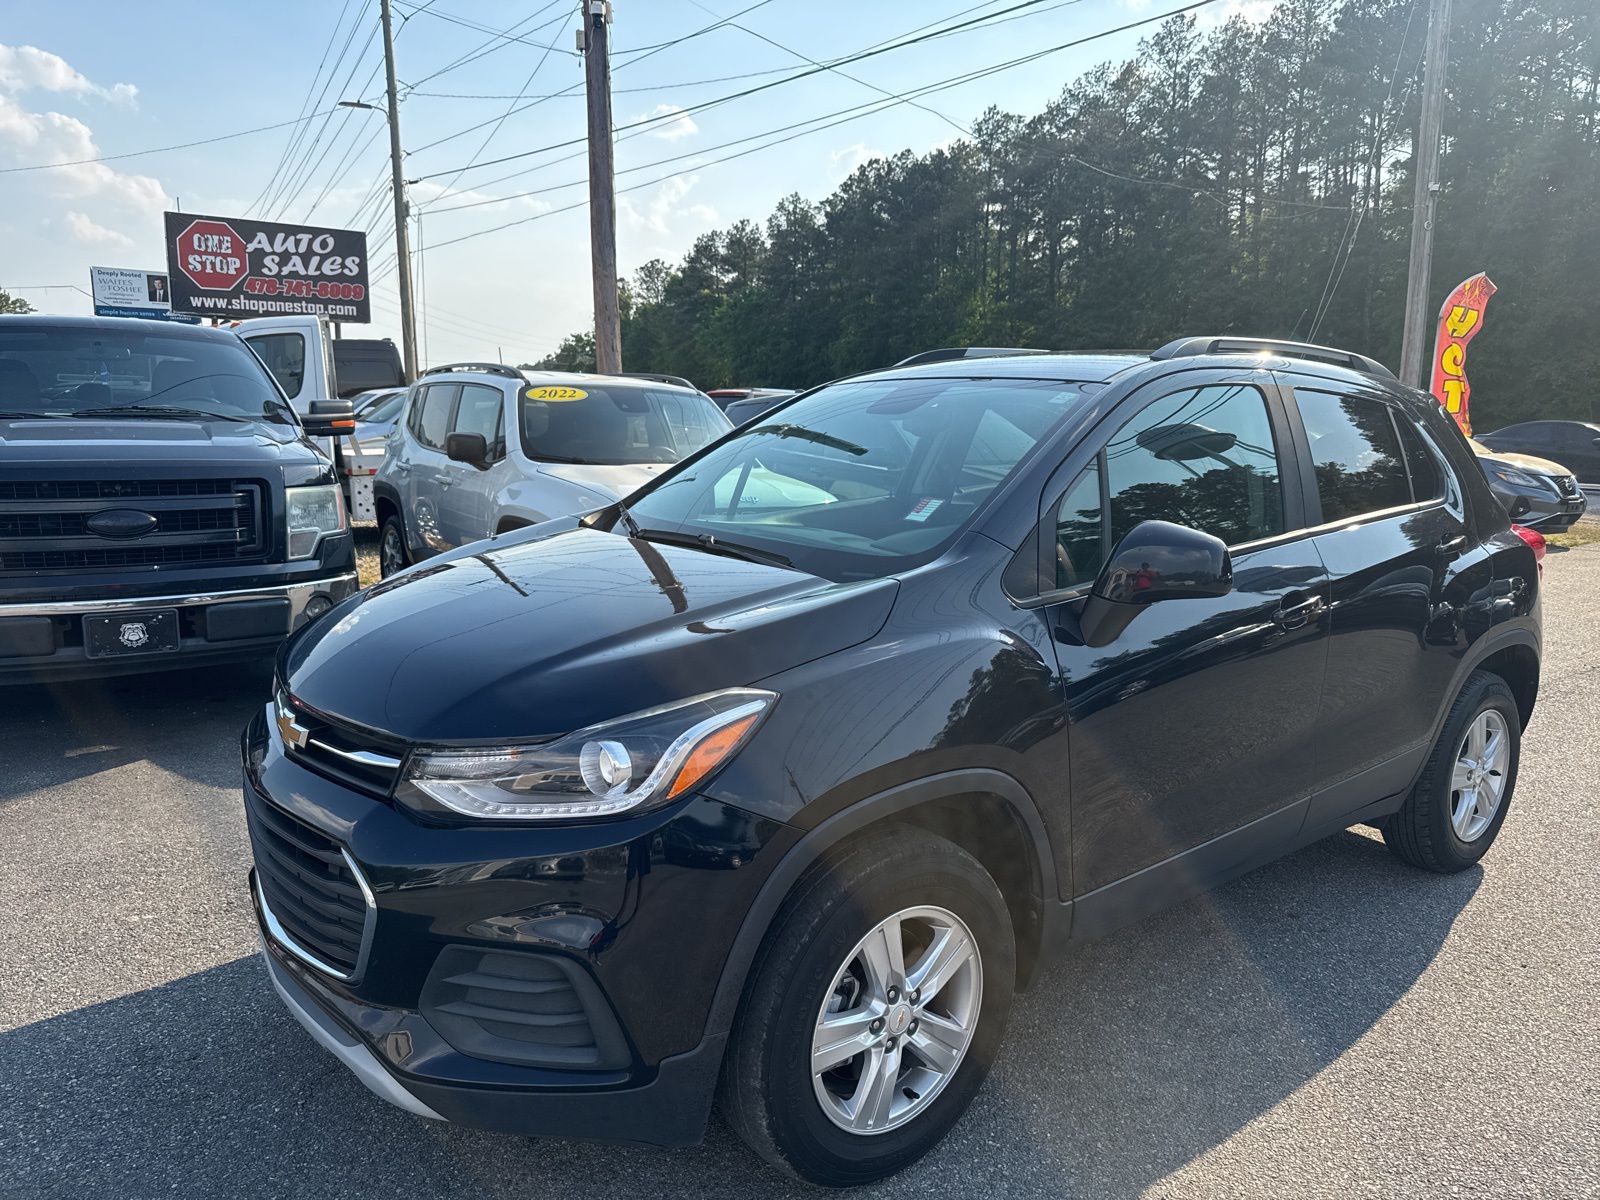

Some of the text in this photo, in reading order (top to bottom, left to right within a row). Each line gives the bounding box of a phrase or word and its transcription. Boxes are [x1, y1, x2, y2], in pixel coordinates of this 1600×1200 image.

[193, 233, 233, 254] ONE
[245, 231, 335, 254] AUTO
[98, 270, 118, 278] Deeply
[187, 254, 241, 275] STOP
[261, 254, 361, 277] SALES
[243, 276, 365, 301] 478-741-8009
[190, 295, 357, 317] www.shoponestop.com
[538, 389, 577, 399] 2022
